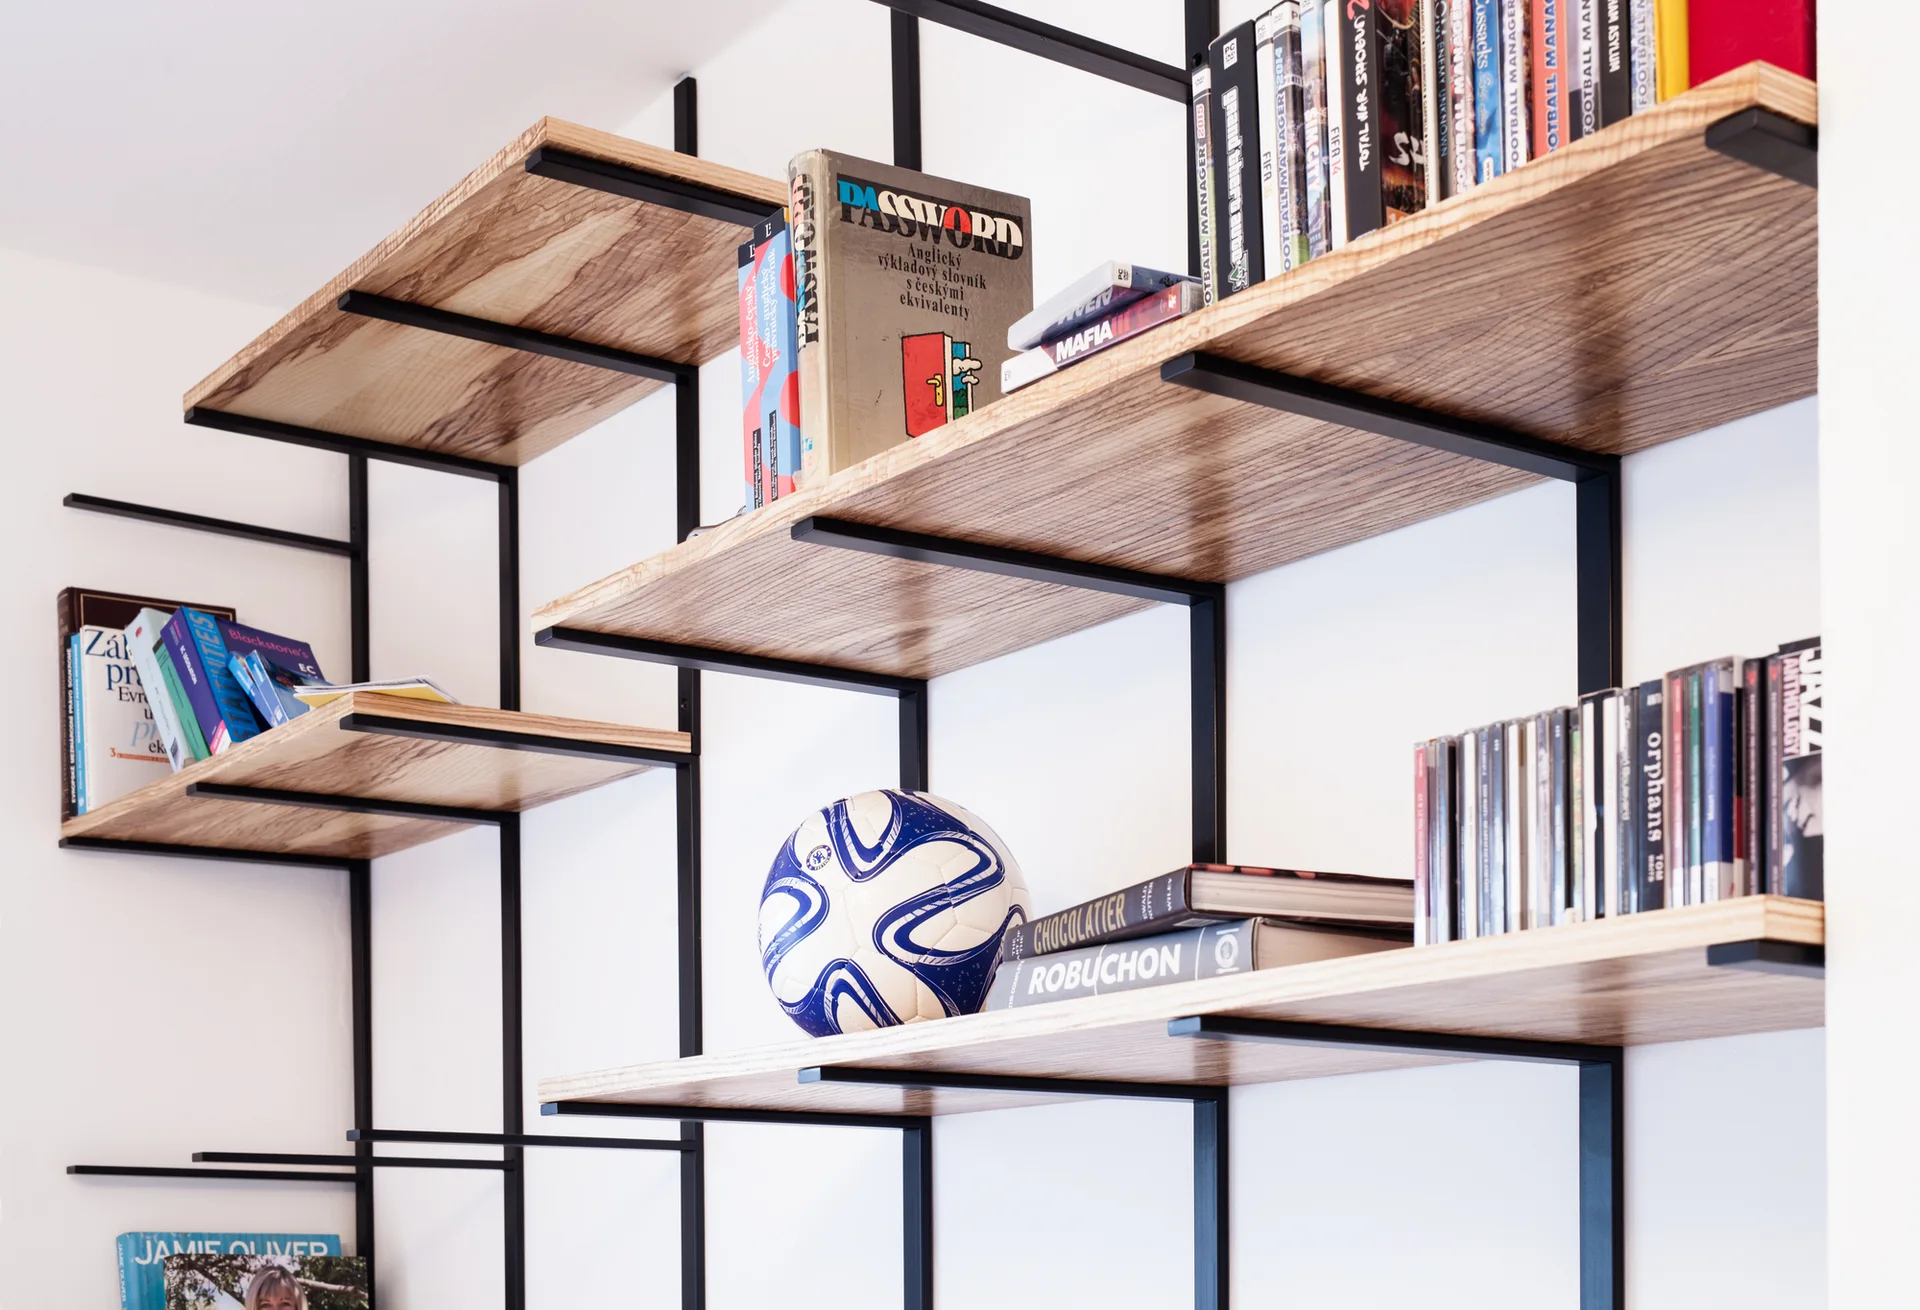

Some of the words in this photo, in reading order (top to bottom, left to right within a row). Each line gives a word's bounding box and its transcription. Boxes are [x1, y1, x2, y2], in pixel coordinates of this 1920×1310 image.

[1353, 14, 1369, 86] SHOGUN
[1475, 0, 1492, 70] Cossacks
[1507, 0, 1518, 83] MANAGER
[1608, 24, 1621, 73] ASYLUM
[1275, 47, 1283, 86] 2014
[1437, 41, 1446, 83] ENEMY
[1636, 15, 1648, 105] FOOTBALL
[1356, 88, 1370, 122] WAR
[1546, 74, 1559, 153] OTBALL
[1583, 46, 1596, 136] FOOTBALL
[1196, 105, 1205, 138] 2015
[1277, 91, 1289, 188] MANAGER
[1331, 126, 1341, 159] FIFA
[1438, 88, 1448, 157] UNKNOWN
[1509, 89, 1520, 170] FOOTBALL
[1263, 151, 1272, 182] FIFA
[1304, 107, 1321, 190] SIMCITY
[1331, 159, 1341, 176] 14
[1358, 122, 1372, 171] TOTAL
[1199, 145, 1209, 234] MANAGER
[837, 176, 1024, 261] PASSWORD
[1280, 189, 1291, 271] OOTBALL
[792, 174, 820, 350] PASSWORD
[878, 253, 938, 281] výkladový
[942, 268, 987, 290] slovník
[908, 242, 962, 271] Anglický
[1201, 240, 1212, 307] OTBALL
[900, 291, 971, 321] ekvivalenty
[906, 278, 912, 290] s
[915, 277, 965, 301] českými
[1056, 320, 1113, 363] MAFIA
[228, 629, 309, 660] Blackstone's
[298, 662, 316, 675] EC
[1783, 656, 1800, 755] ANTHOLOGY
[1644, 732, 1665, 842] orphans
[1655, 853, 1664, 881] TOM
[1033, 893, 1127, 955] CHOCOLATIER
[1146, 881, 1154, 920] NOTTER
[1028, 943, 1182, 995] ROBUCHON
[135, 1240, 221, 1265] JAMIE
[229, 1240, 328, 1257] OLIVER
[119, 1269, 127, 1302] OLIVER
